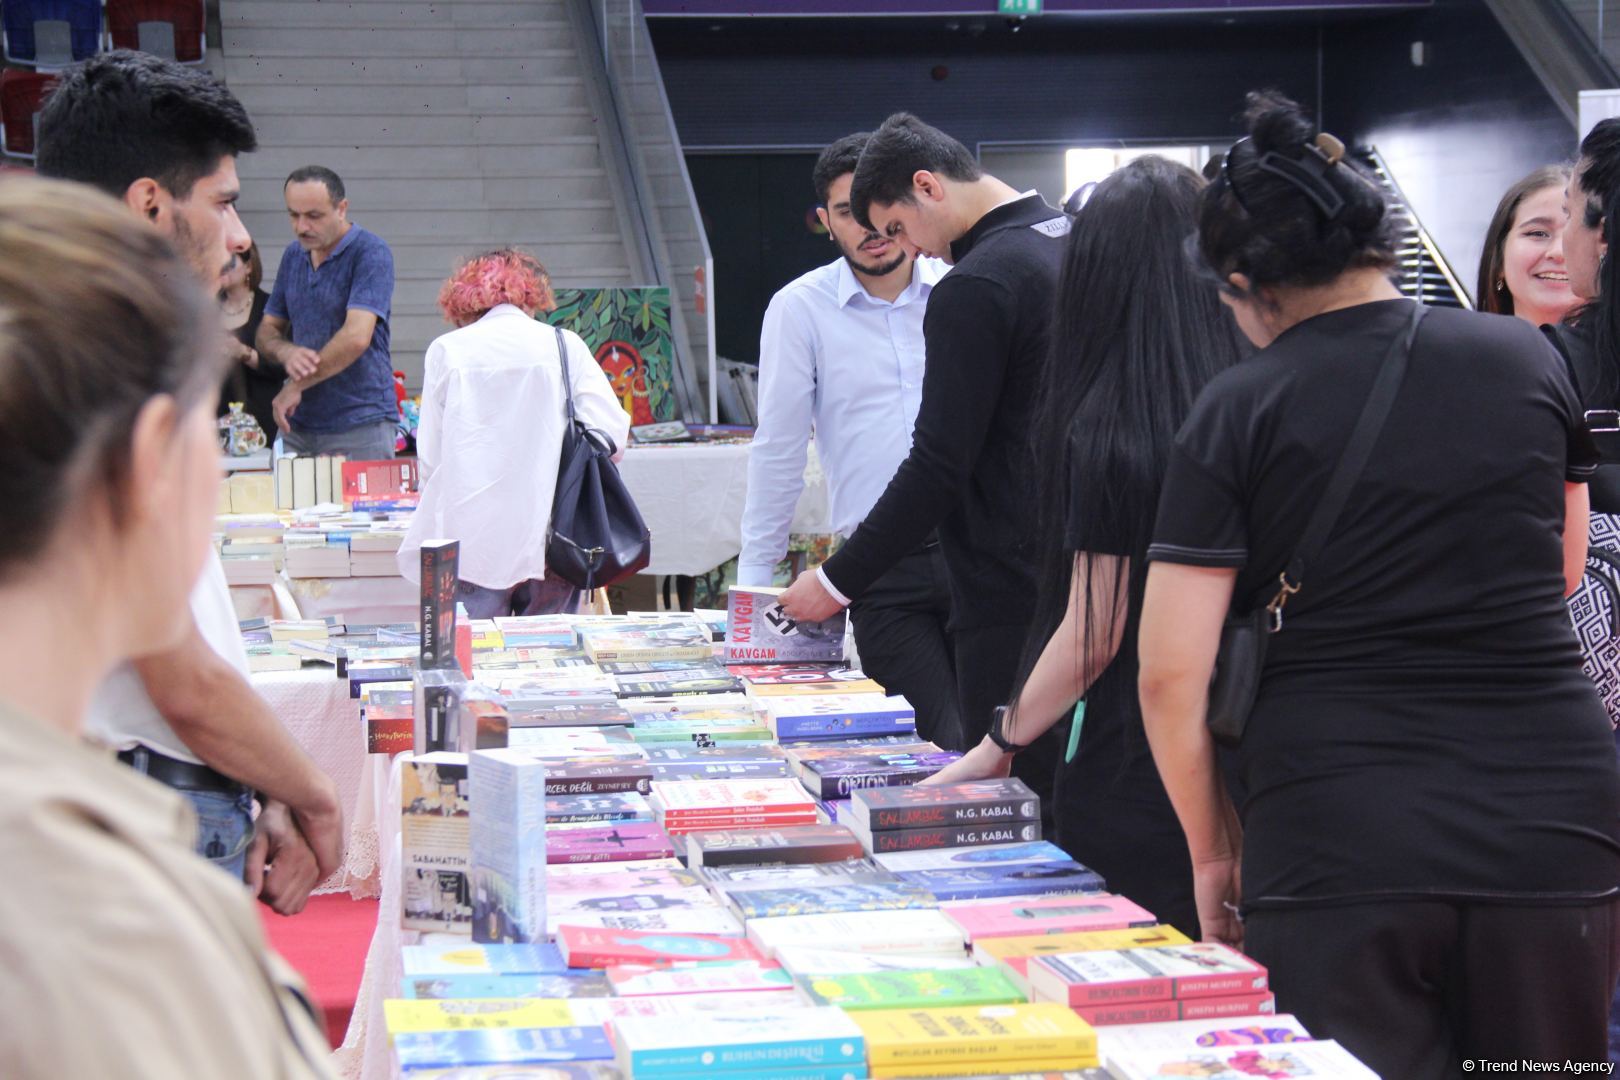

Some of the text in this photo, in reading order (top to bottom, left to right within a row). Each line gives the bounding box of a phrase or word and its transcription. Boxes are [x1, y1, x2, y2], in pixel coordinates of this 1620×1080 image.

[733, 593, 753, 643] KAVGAM
[424, 623, 432, 647] KABAL
[730, 648, 776, 659] KAVGAM
[545, 784, 567, 794] RÇEK
[569, 781, 594, 793] DEĞİL
[955, 808, 978, 818] N.G.
[981, 807, 1013, 817] KABAL
[956, 832, 979, 843] N.G.
[982, 831, 1014, 841] KABAL
